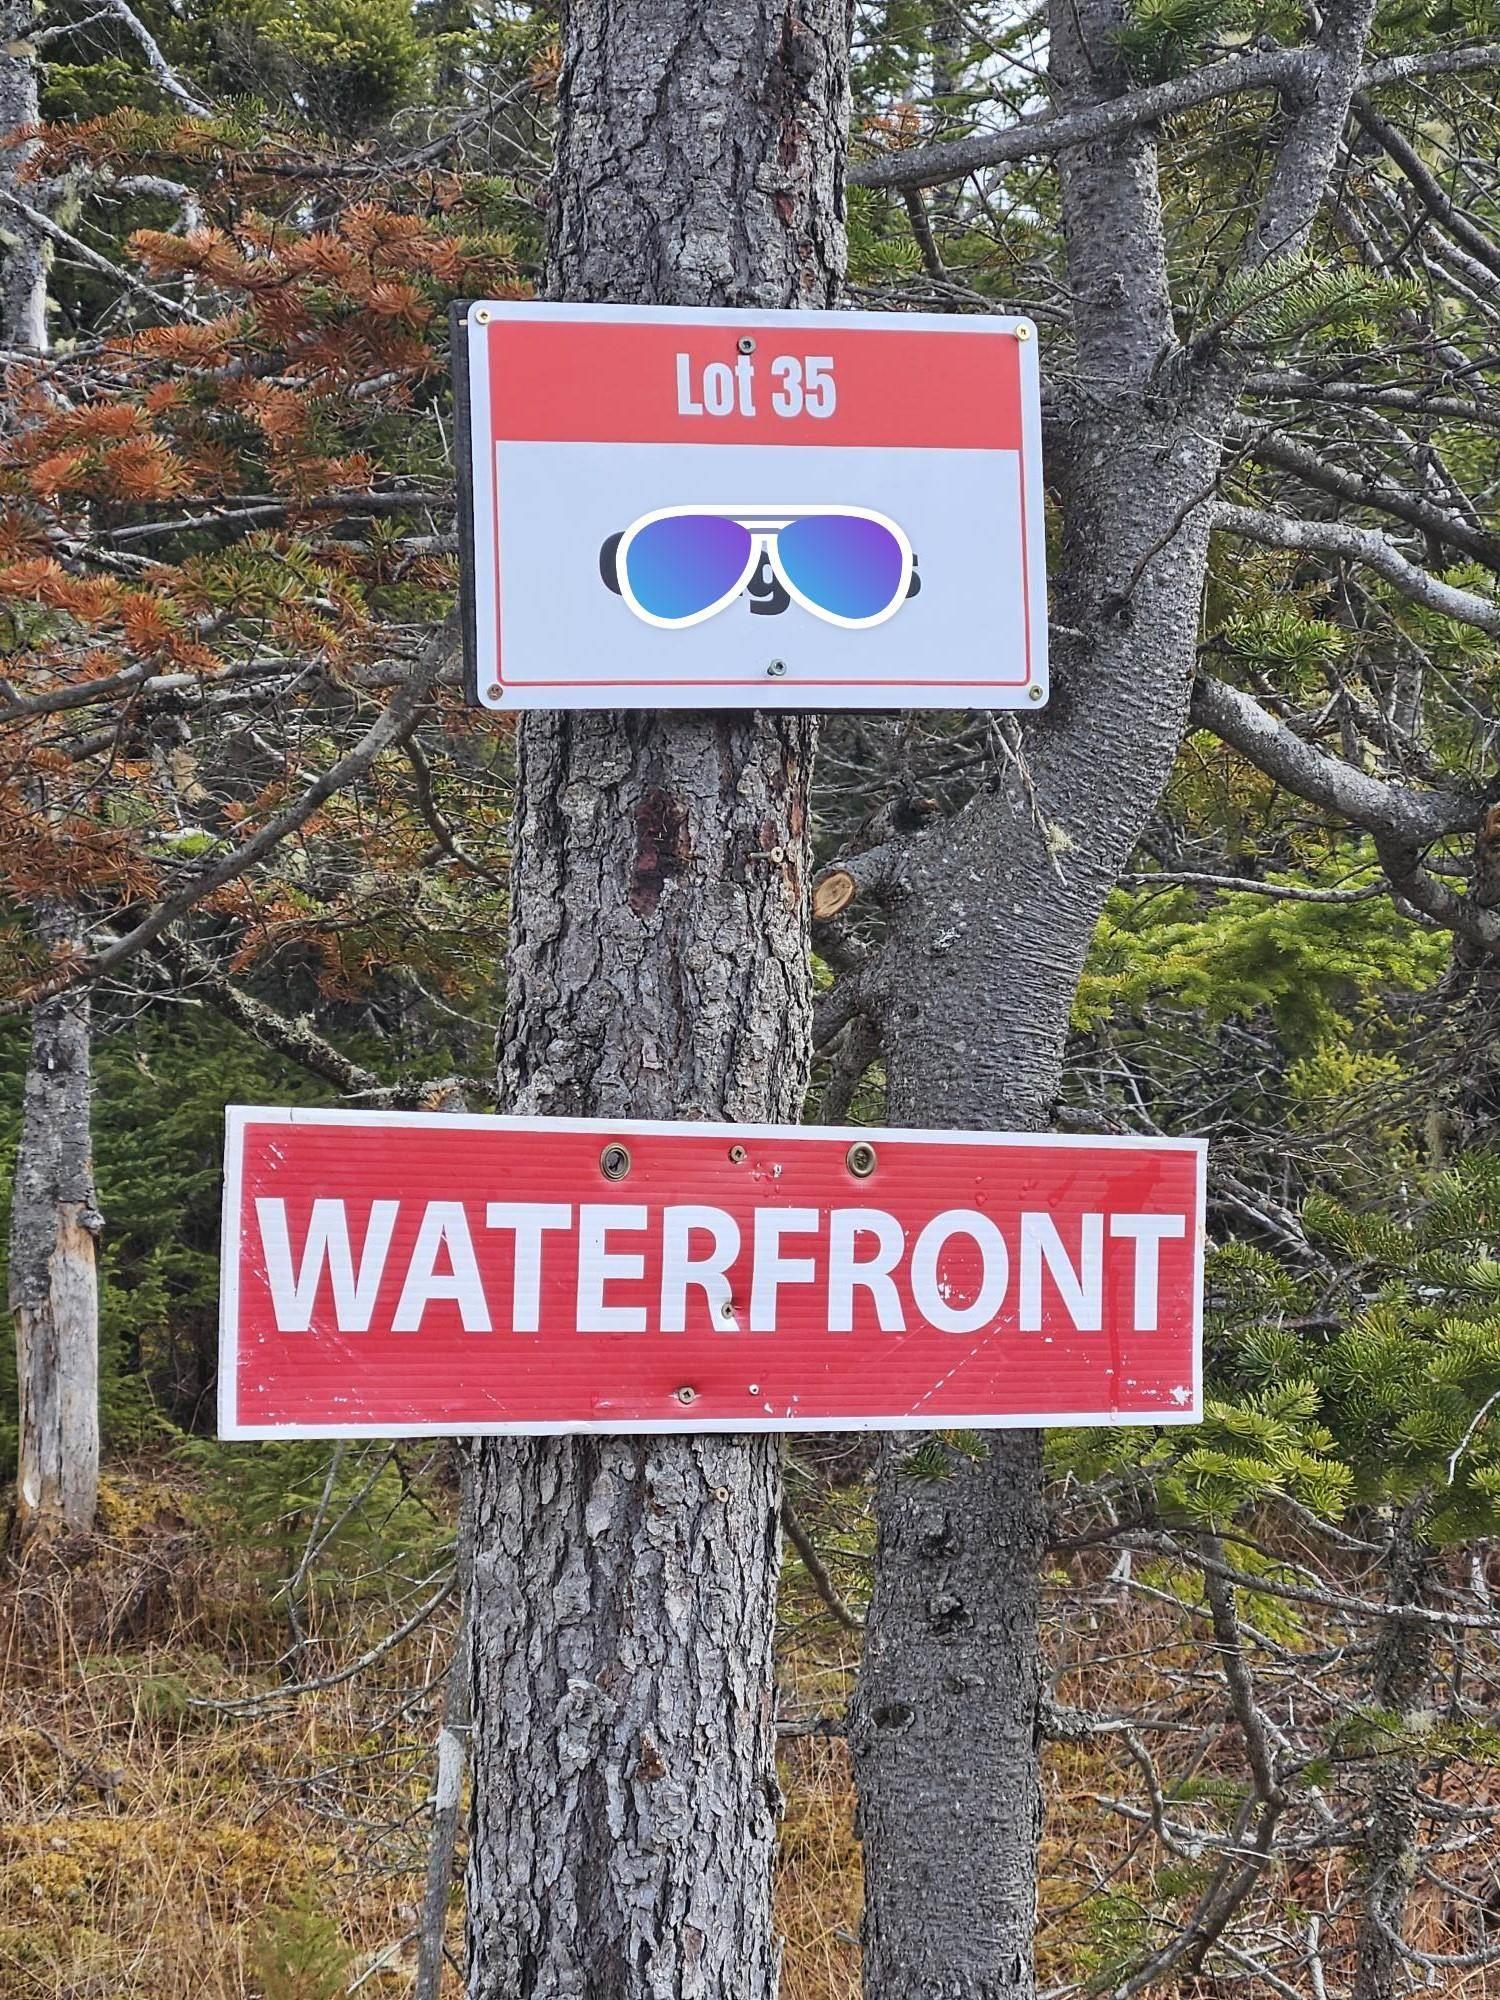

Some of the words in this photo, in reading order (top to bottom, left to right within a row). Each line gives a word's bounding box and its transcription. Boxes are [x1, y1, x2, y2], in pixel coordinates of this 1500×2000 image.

[676, 353, 756, 417] Lot
[771, 356, 836, 418] 35
[254, 1197, 1186, 1334] WATERFRONT
